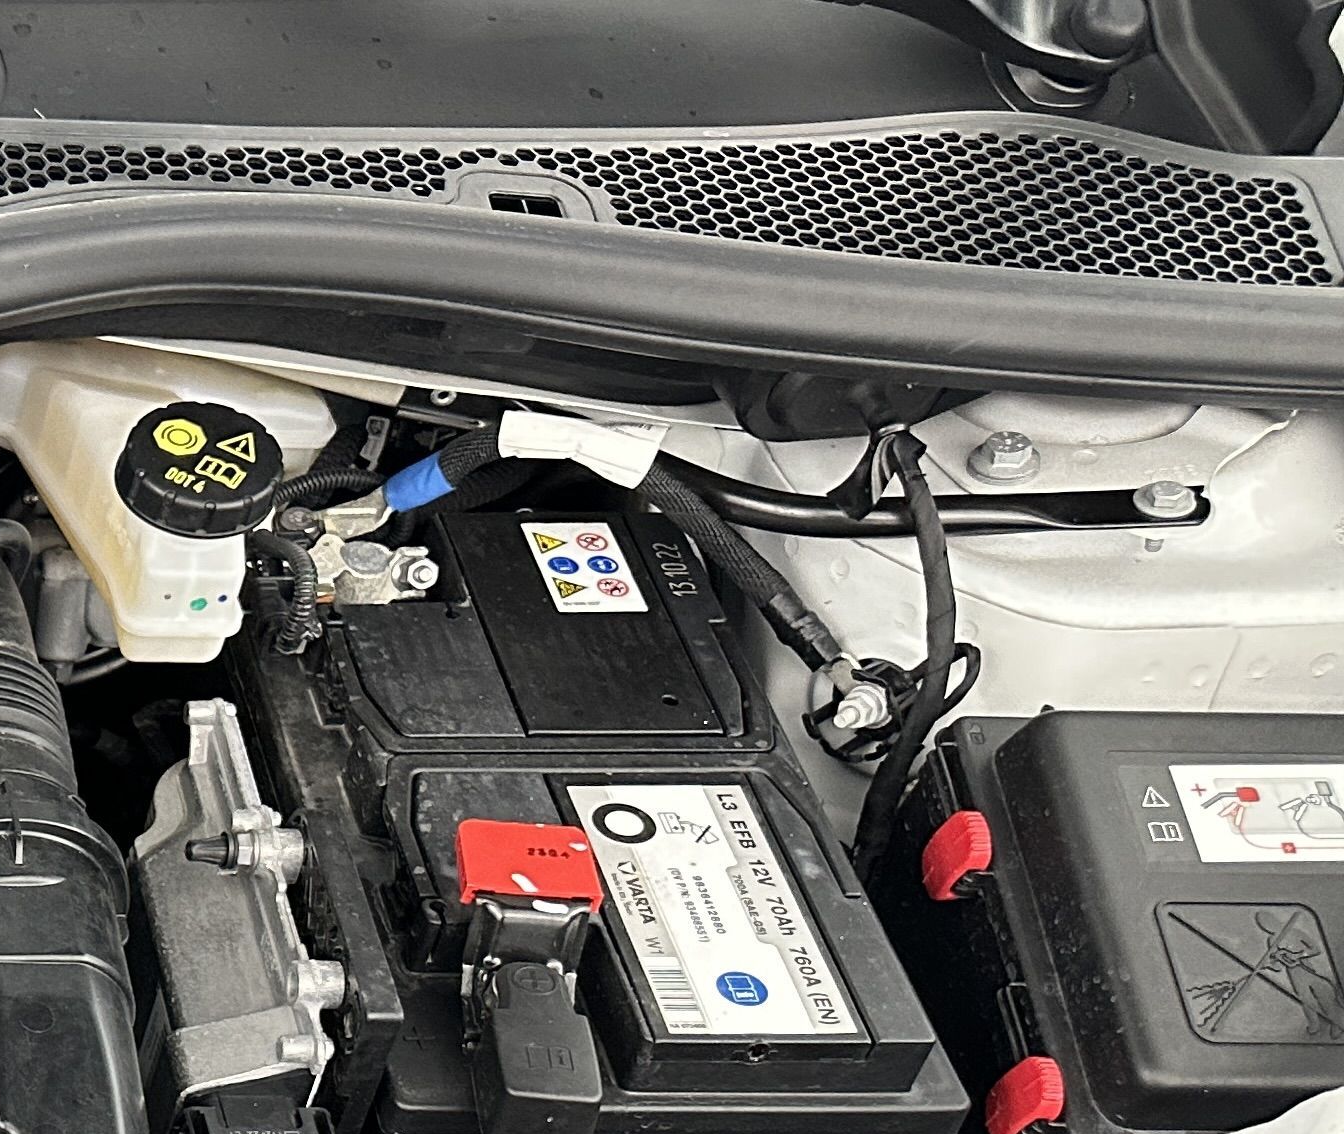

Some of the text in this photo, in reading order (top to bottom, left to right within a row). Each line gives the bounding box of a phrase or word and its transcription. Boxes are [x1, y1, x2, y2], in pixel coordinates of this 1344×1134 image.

[165, 467, 206, 493] DOT 4
[652, 542, 699, 598] 13.10.22
[626, 878, 656, 926] VARTA
[716, 793, 841, 1027] L3 EFB 12V 70Ah 760A (EN)
